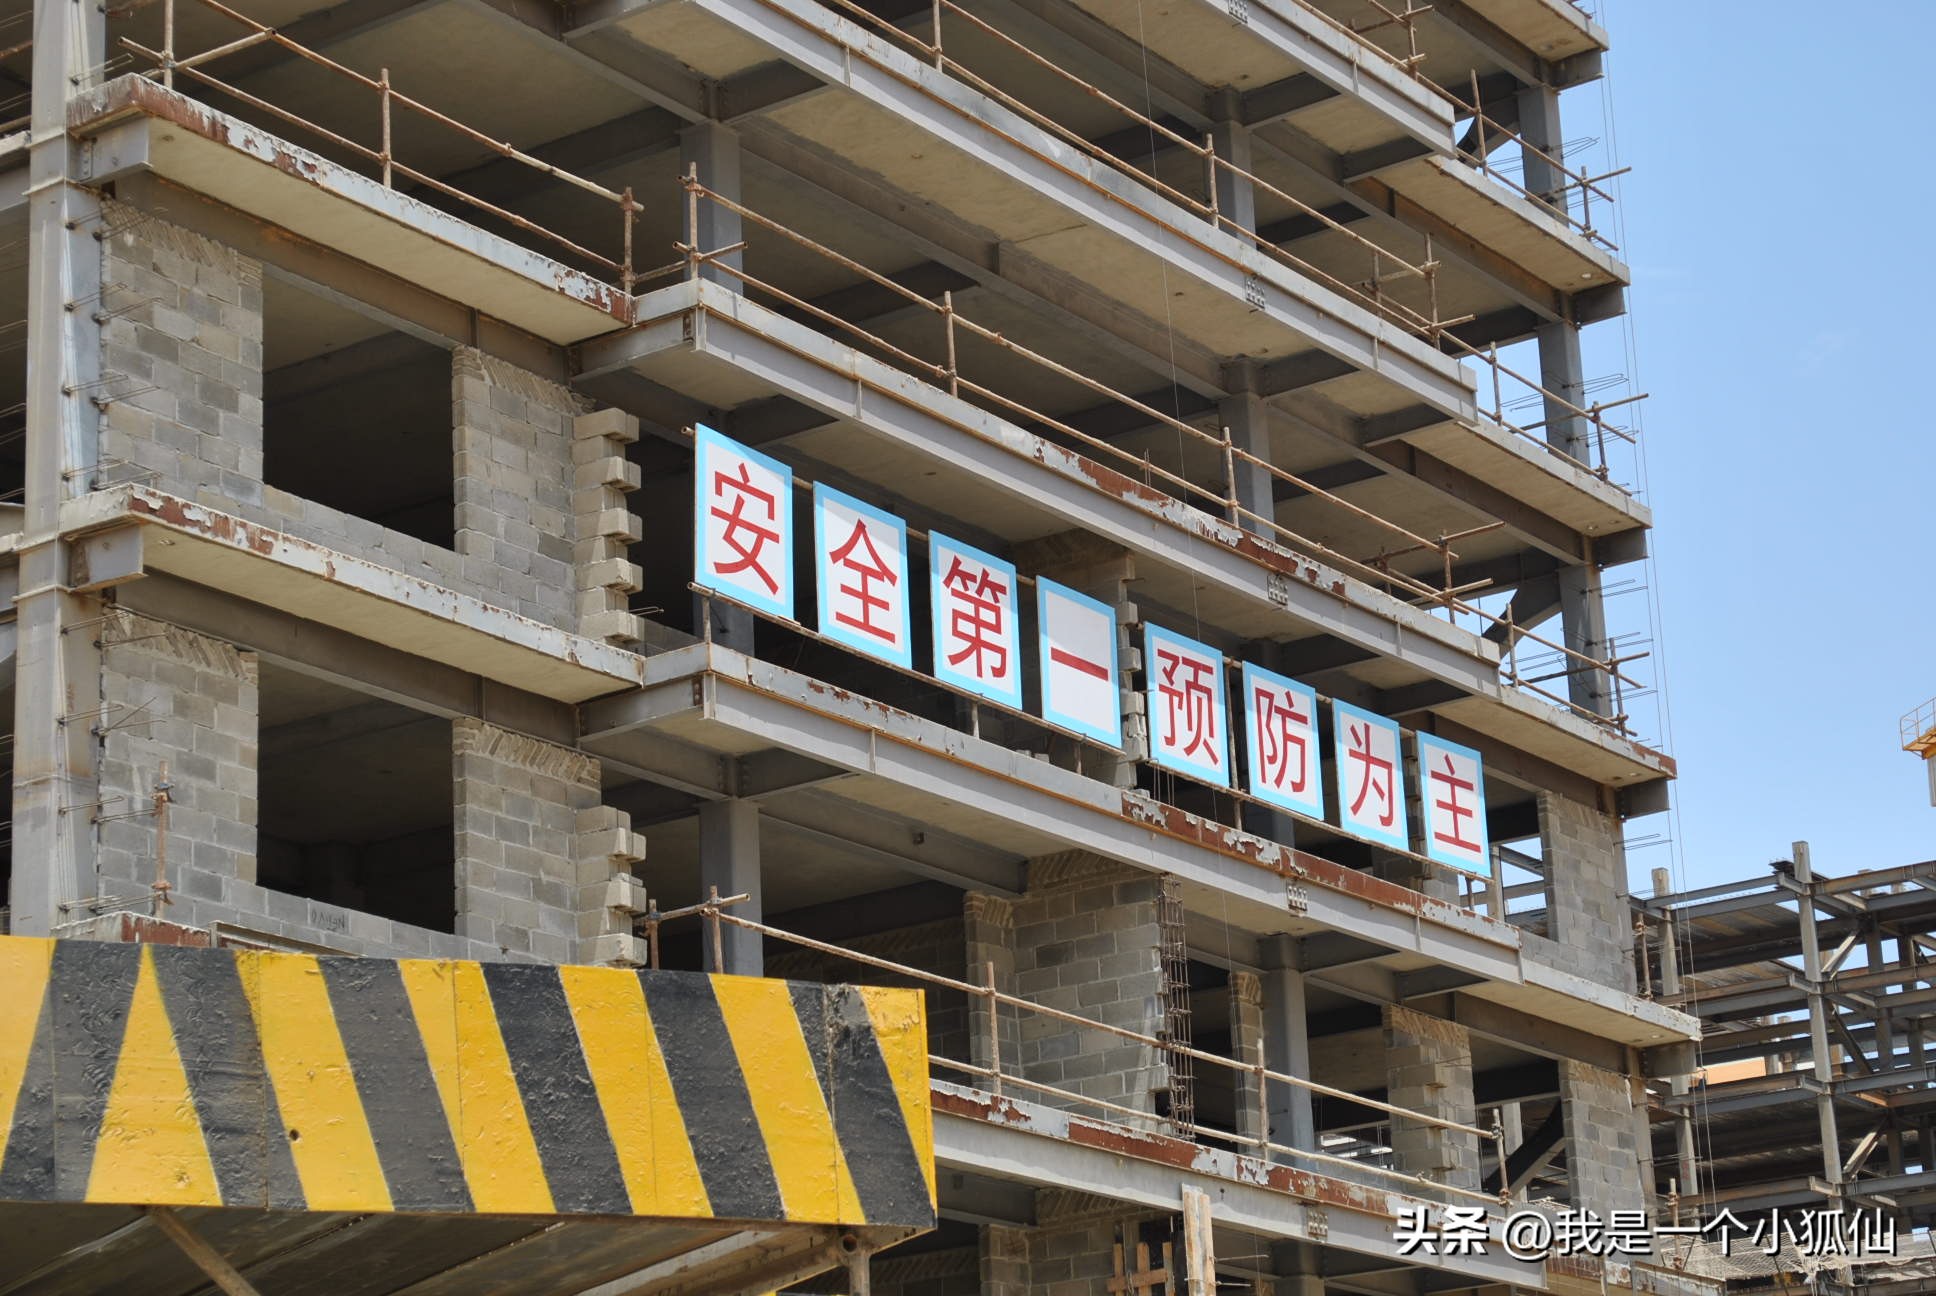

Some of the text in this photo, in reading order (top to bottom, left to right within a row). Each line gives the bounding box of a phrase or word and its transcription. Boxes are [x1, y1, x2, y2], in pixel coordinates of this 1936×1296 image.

[711, 463, 1482, 853] 安全第一预防为主
